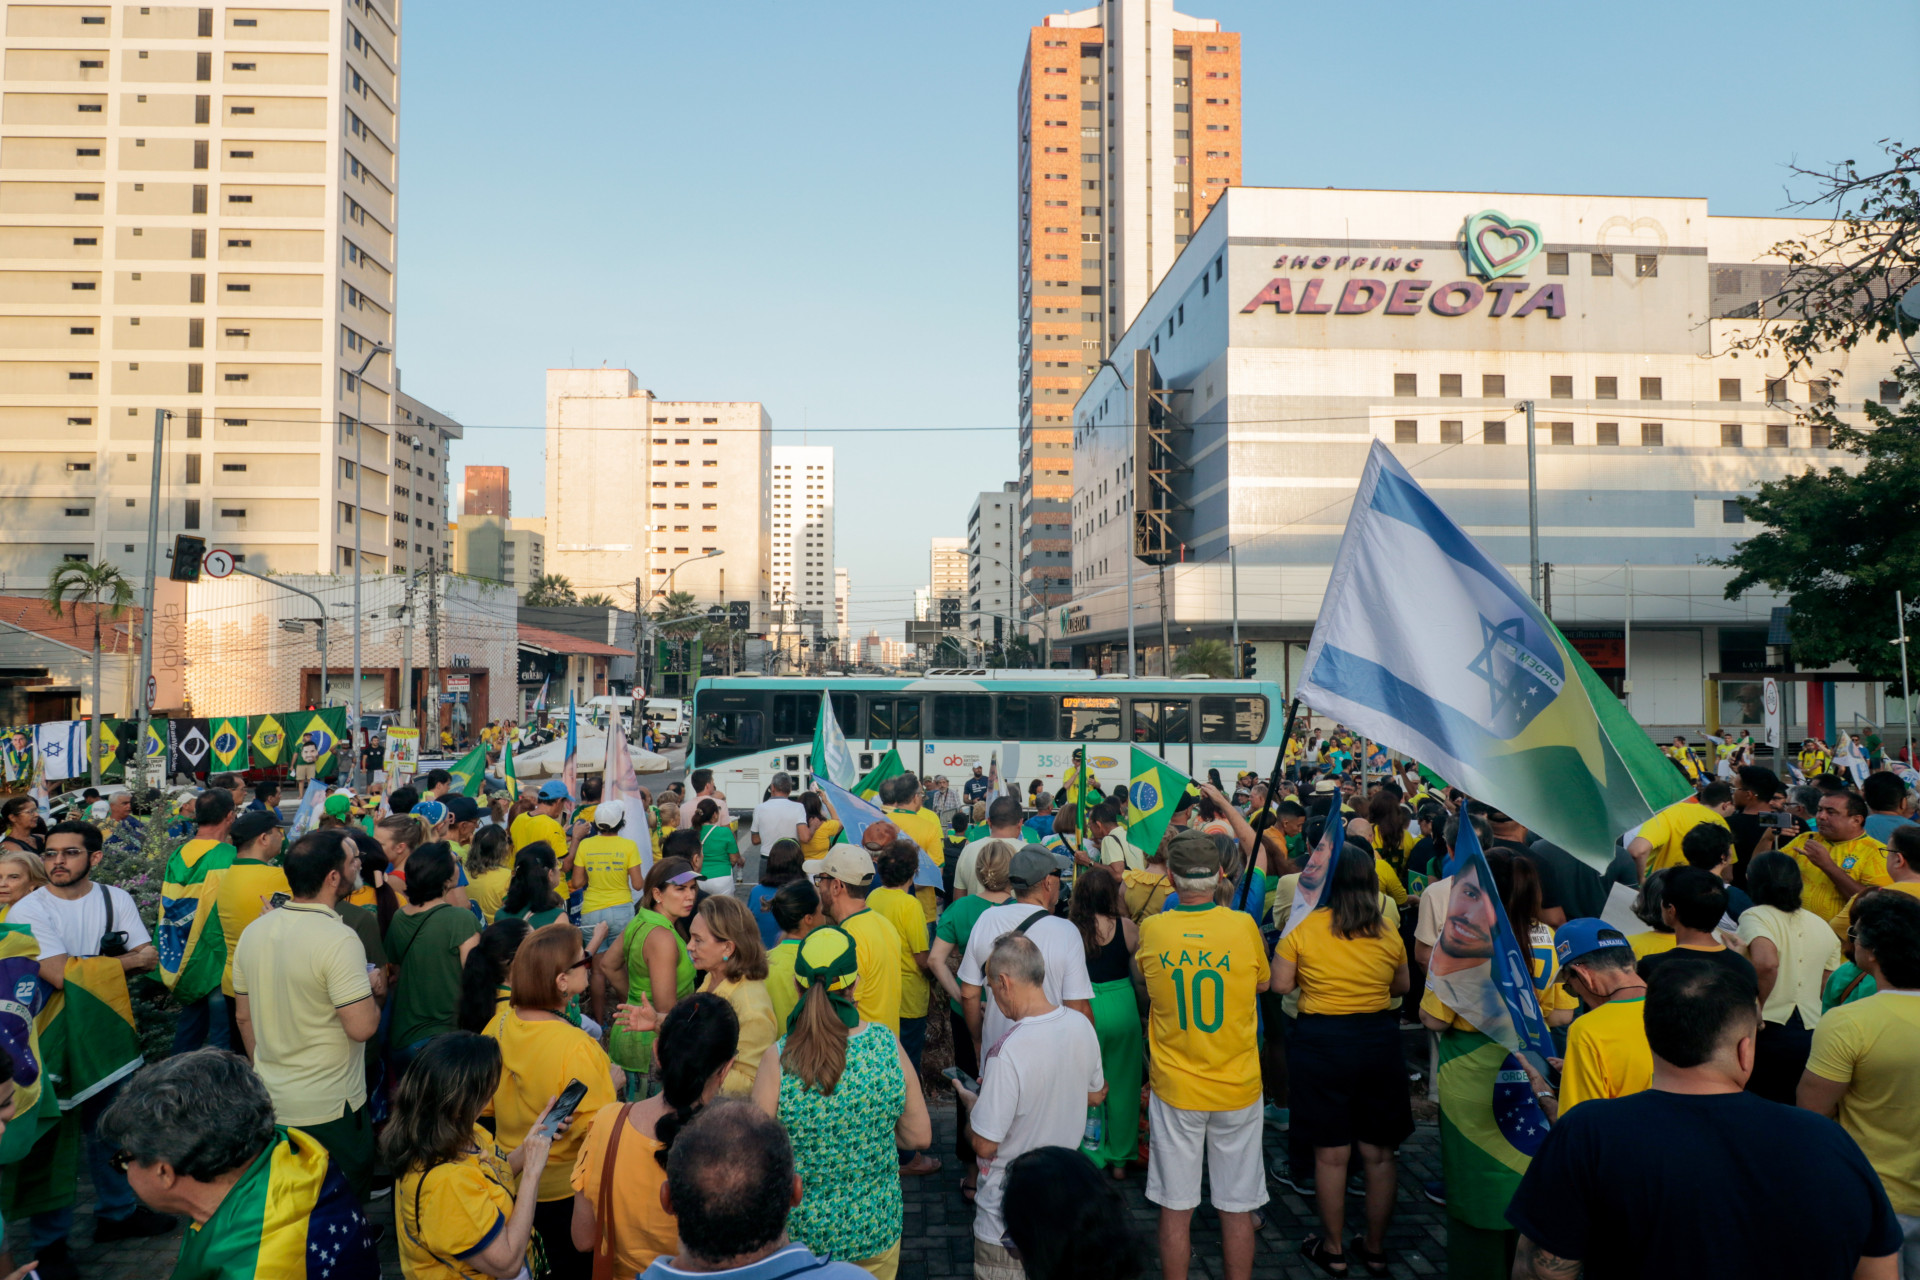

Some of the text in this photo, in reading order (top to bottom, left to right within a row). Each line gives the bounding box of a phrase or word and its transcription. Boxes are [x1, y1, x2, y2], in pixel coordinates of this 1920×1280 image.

[1273, 254, 1424, 272] SHOPPING
[1240, 277, 1566, 319] ALDEOTA
[159, 603, 179, 683] Joiola
[1063, 697, 1078, 708] 079
[1037, 755, 1073, 768] 3584
[1598, 939, 1625, 947] PANAMA
[1159, 950, 1231, 972] KAKÁ
[15, 981, 35, 998] 22
[1171, 968, 1224, 1033] 10
[1501, 1071, 1529, 1081] ORDE
